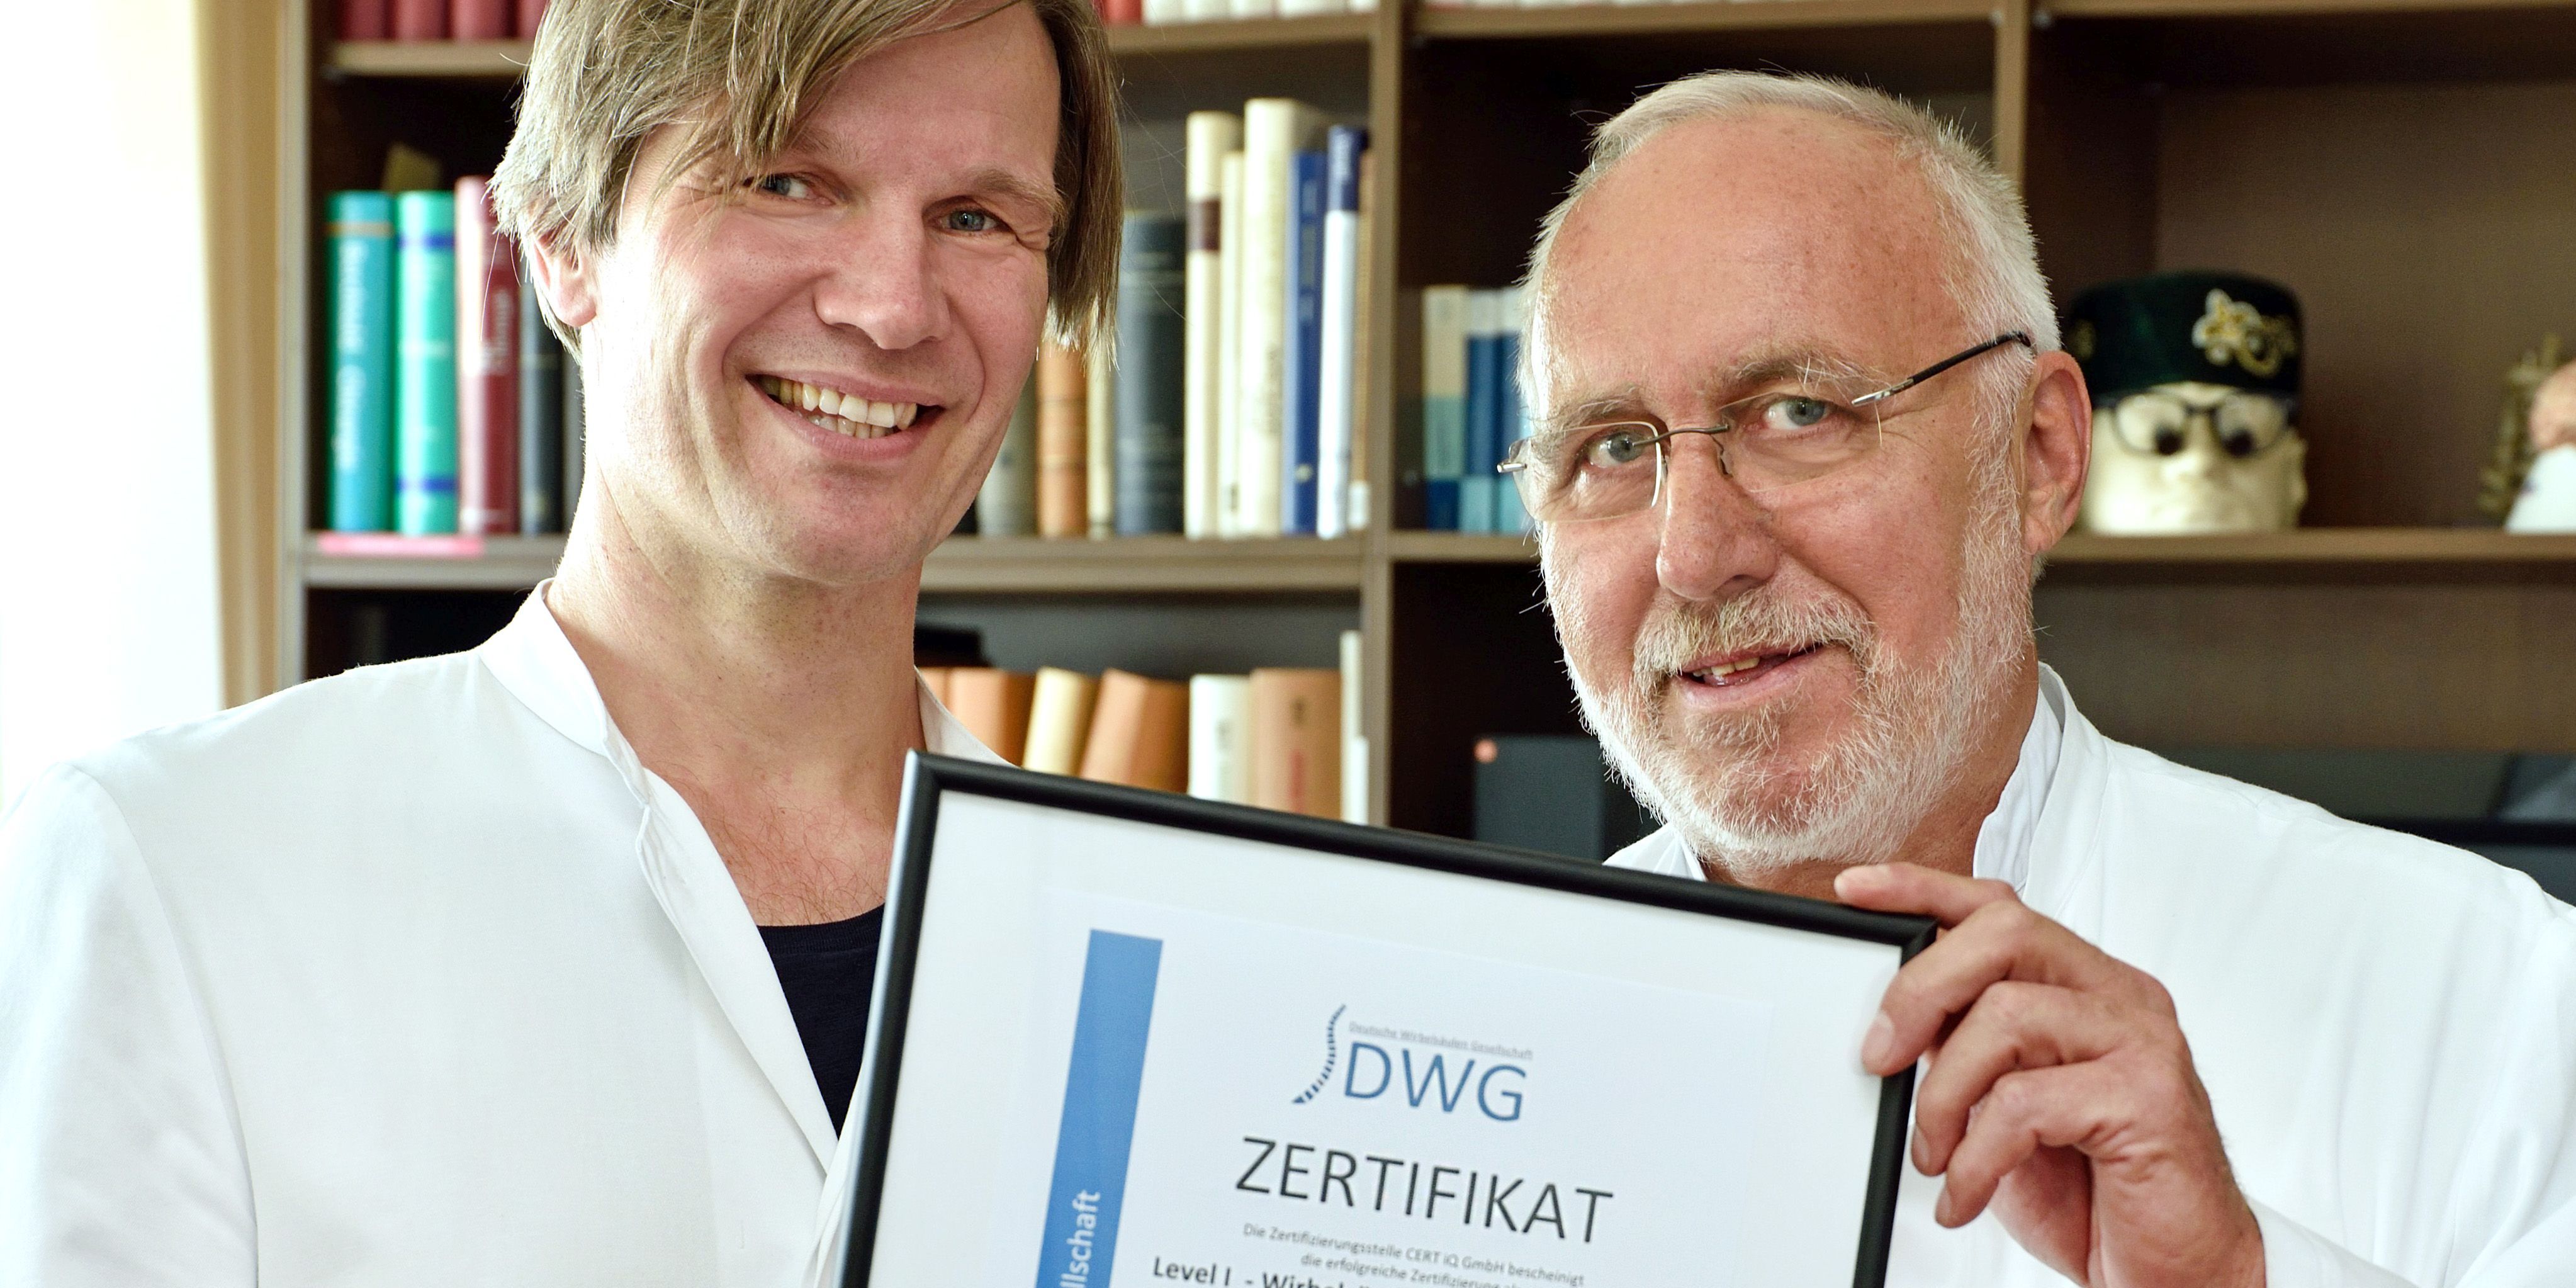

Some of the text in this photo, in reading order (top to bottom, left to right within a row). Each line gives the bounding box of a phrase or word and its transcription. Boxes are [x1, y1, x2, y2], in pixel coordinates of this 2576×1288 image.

[1344, 1042, 1527, 1121] DWG
[1236, 1137, 1613, 1243] ZERTIFIKAT
[1154, 1257, 1217, 1284] Level
[1244, 1223, 1266, 1237] Die
[1269, 1227, 1403, 1258] Zertifizierungsstelle
[1406, 1246, 1441, 1264] CERT
[1461, 1256, 1505, 1275] GmbH
[1509, 1263, 1585, 1287] bescheinigt
[1301, 1253, 1322, 1267] die
[1325, 1258, 1407, 1280] erfolgreiche
